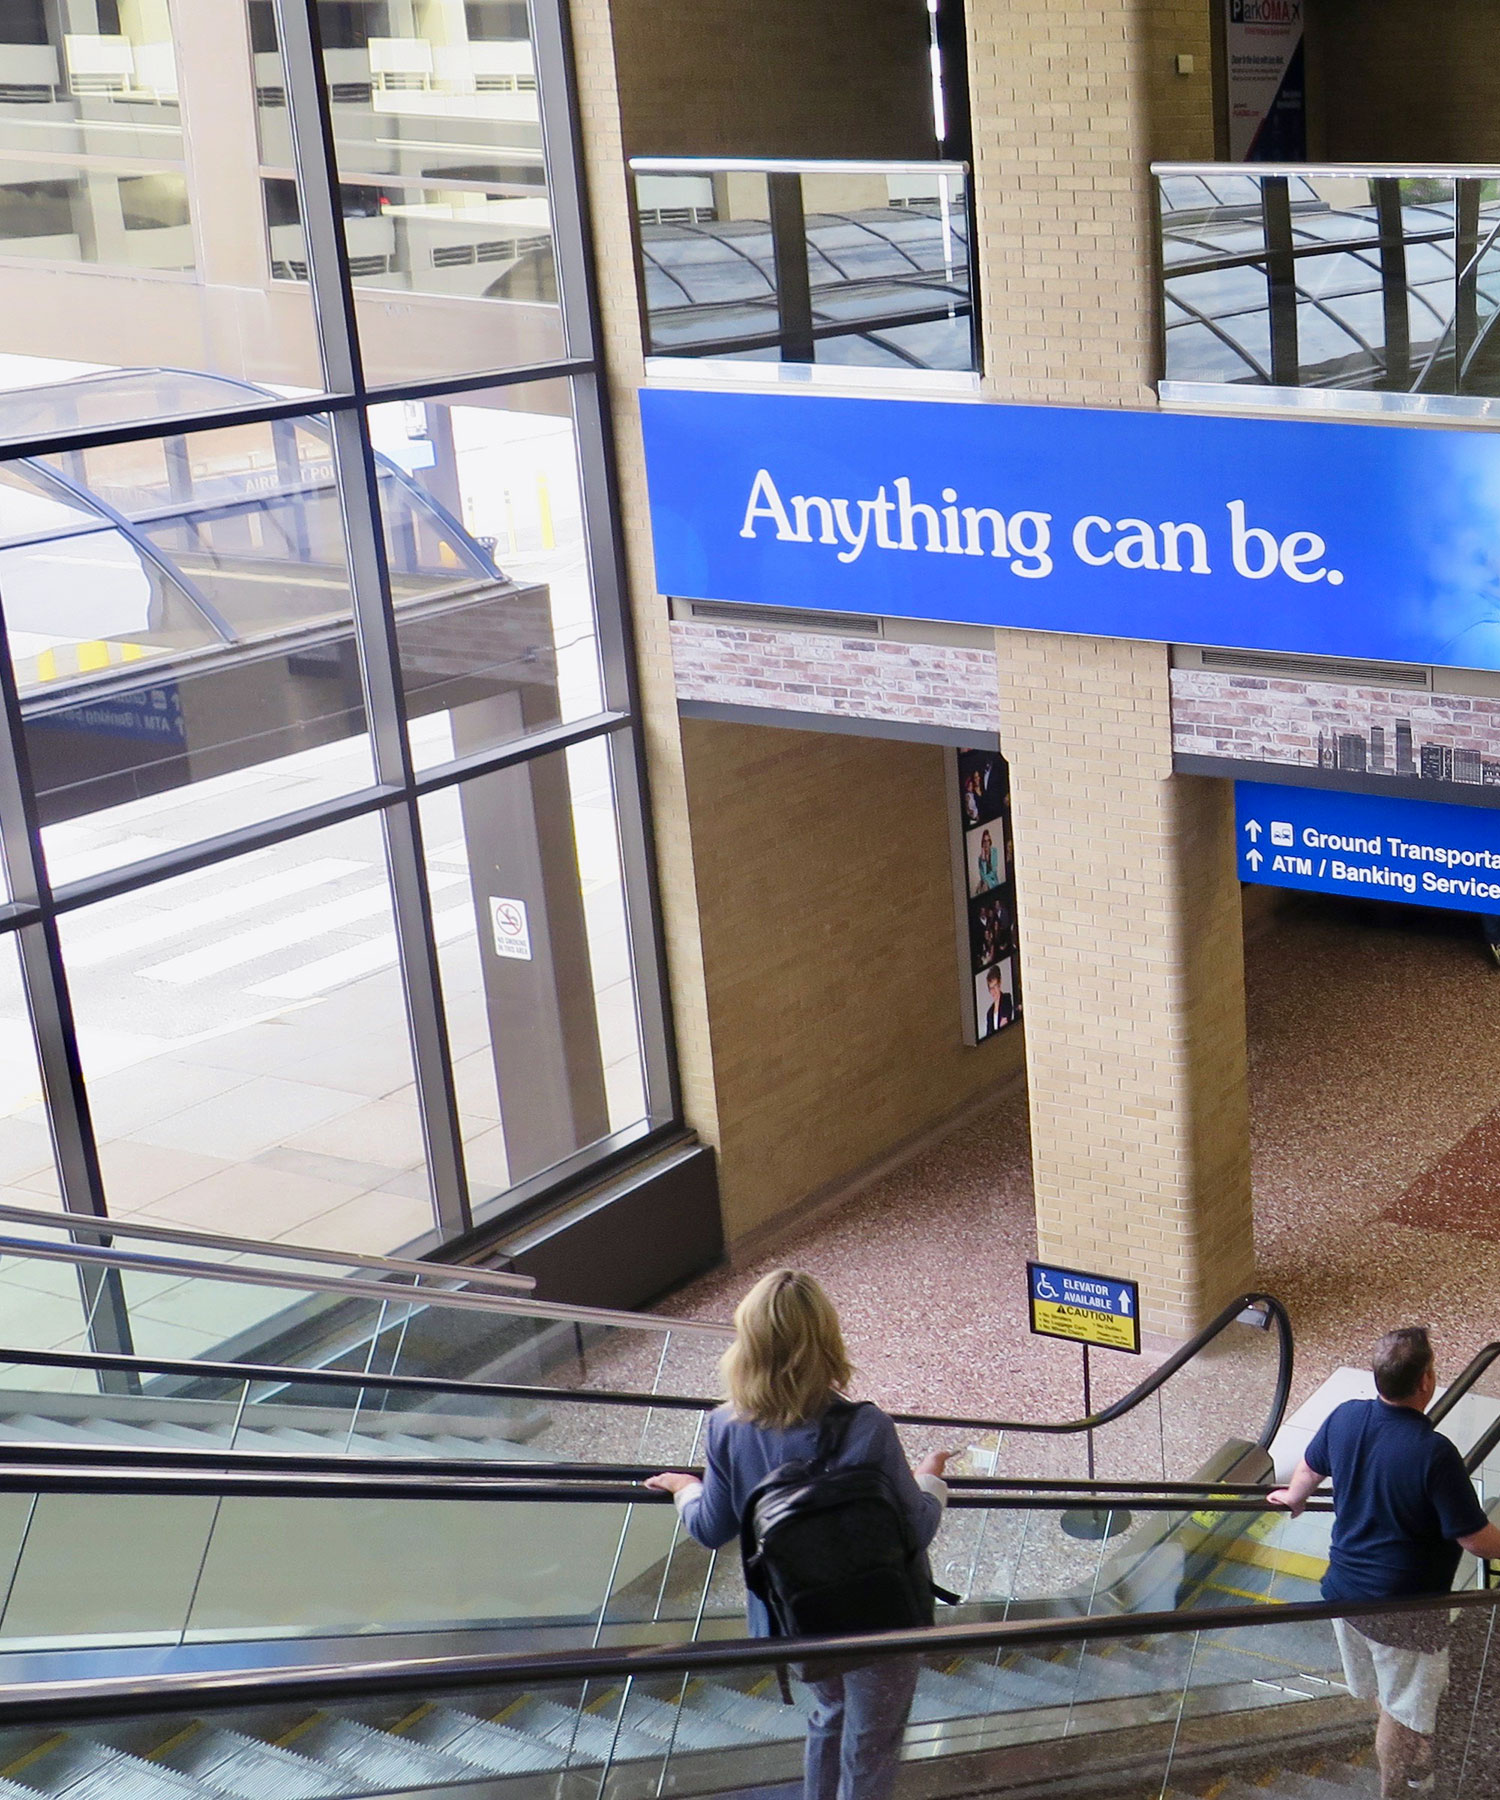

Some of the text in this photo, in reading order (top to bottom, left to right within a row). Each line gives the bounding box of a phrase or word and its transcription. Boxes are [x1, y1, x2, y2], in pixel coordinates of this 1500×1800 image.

[246, 470, 306, 492] AIRPT
[740, 468, 1344, 586] Anything can be.
[1302, 826, 1382, 856] Ground
[1271, 854, 1313, 876] ATM
[1318, 858, 1326, 878] /
[1332, 860, 1417, 894] Banking
[1063, 1278, 1110, 1296] ELEVATOR
[1063, 1291, 1113, 1310] AVAILABLE
[1065, 1306, 1114, 1323] CAUTION
